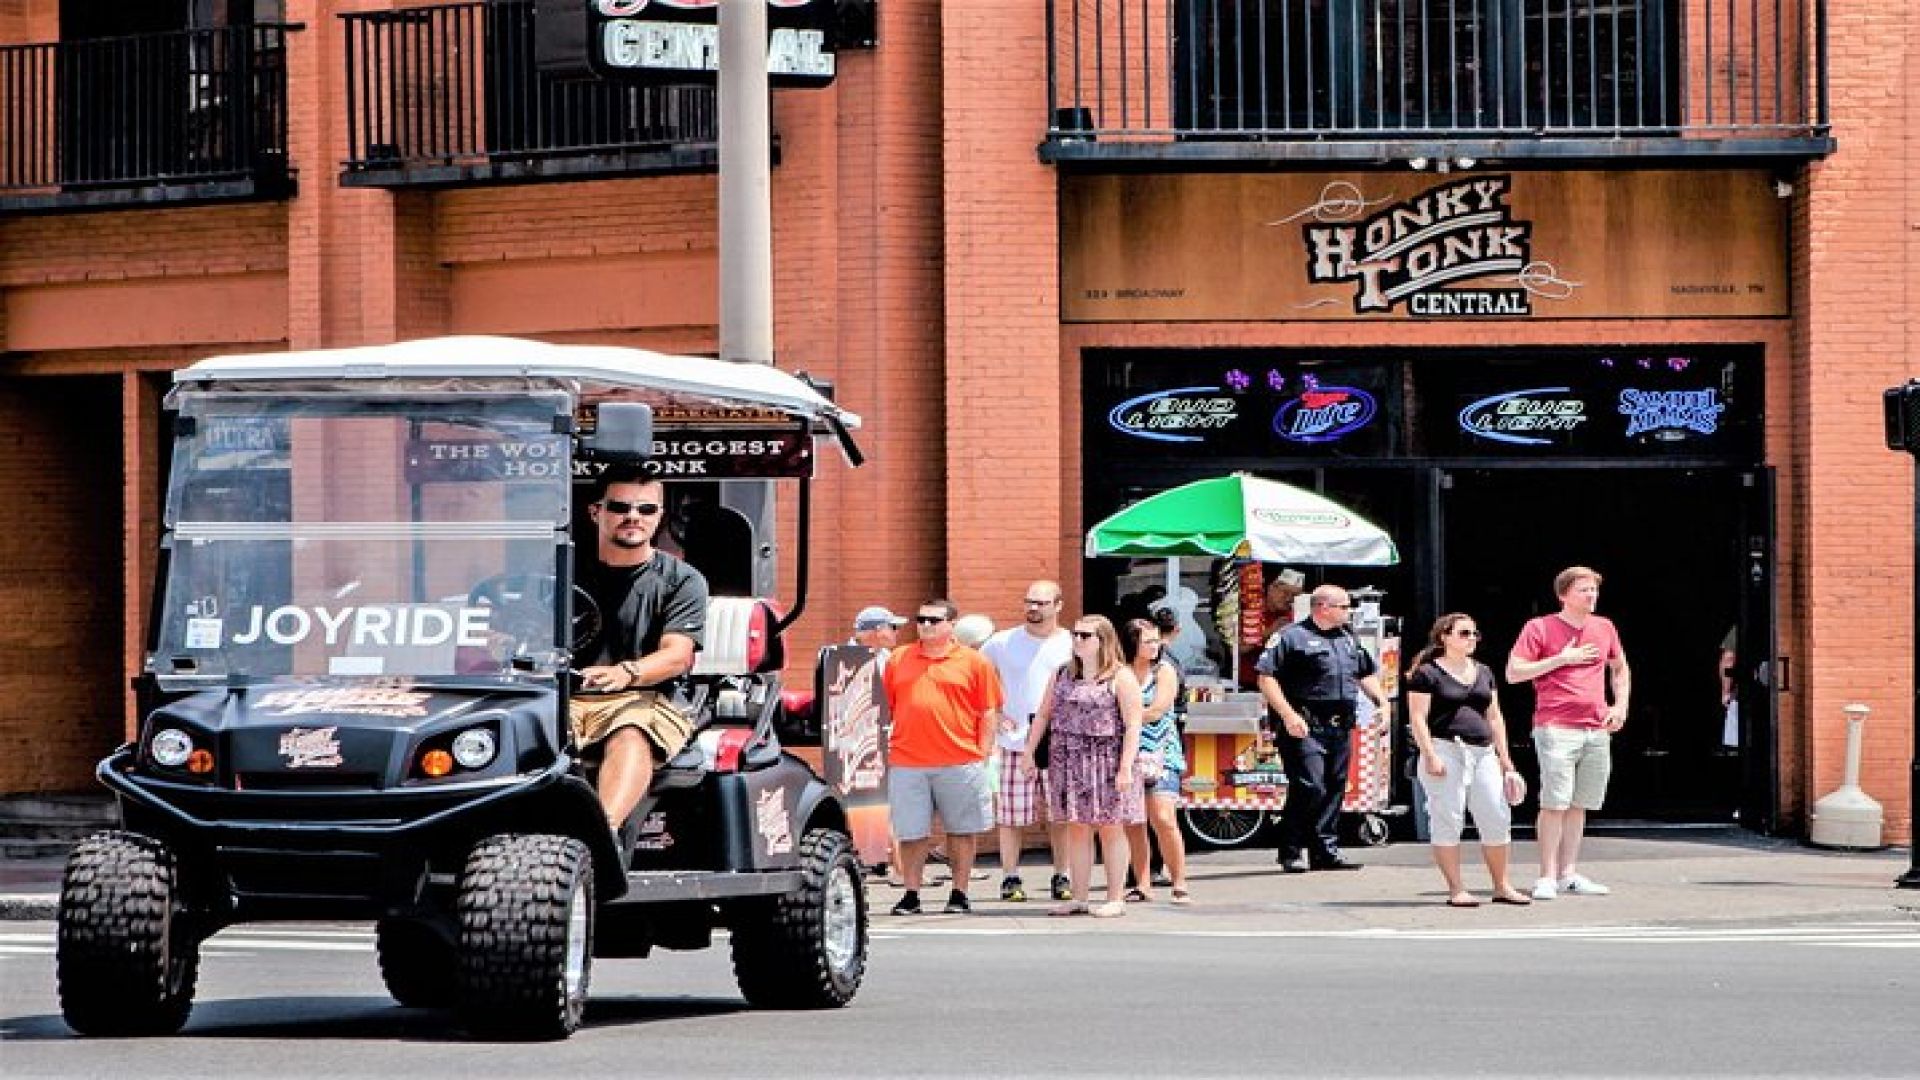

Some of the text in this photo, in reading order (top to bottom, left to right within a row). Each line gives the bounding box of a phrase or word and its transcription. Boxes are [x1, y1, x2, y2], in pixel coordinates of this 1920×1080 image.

[604, 20, 834, 74] CENAL
[1309, 179, 1505, 278] HONKY
[1346, 226, 1525, 308] TONK
[1411, 292, 1528, 314] CENTRAL
[430, 445, 490, 459] THE
[652, 440, 784, 456] BIGGEST
[232, 604, 490, 646] JOYRIDE
